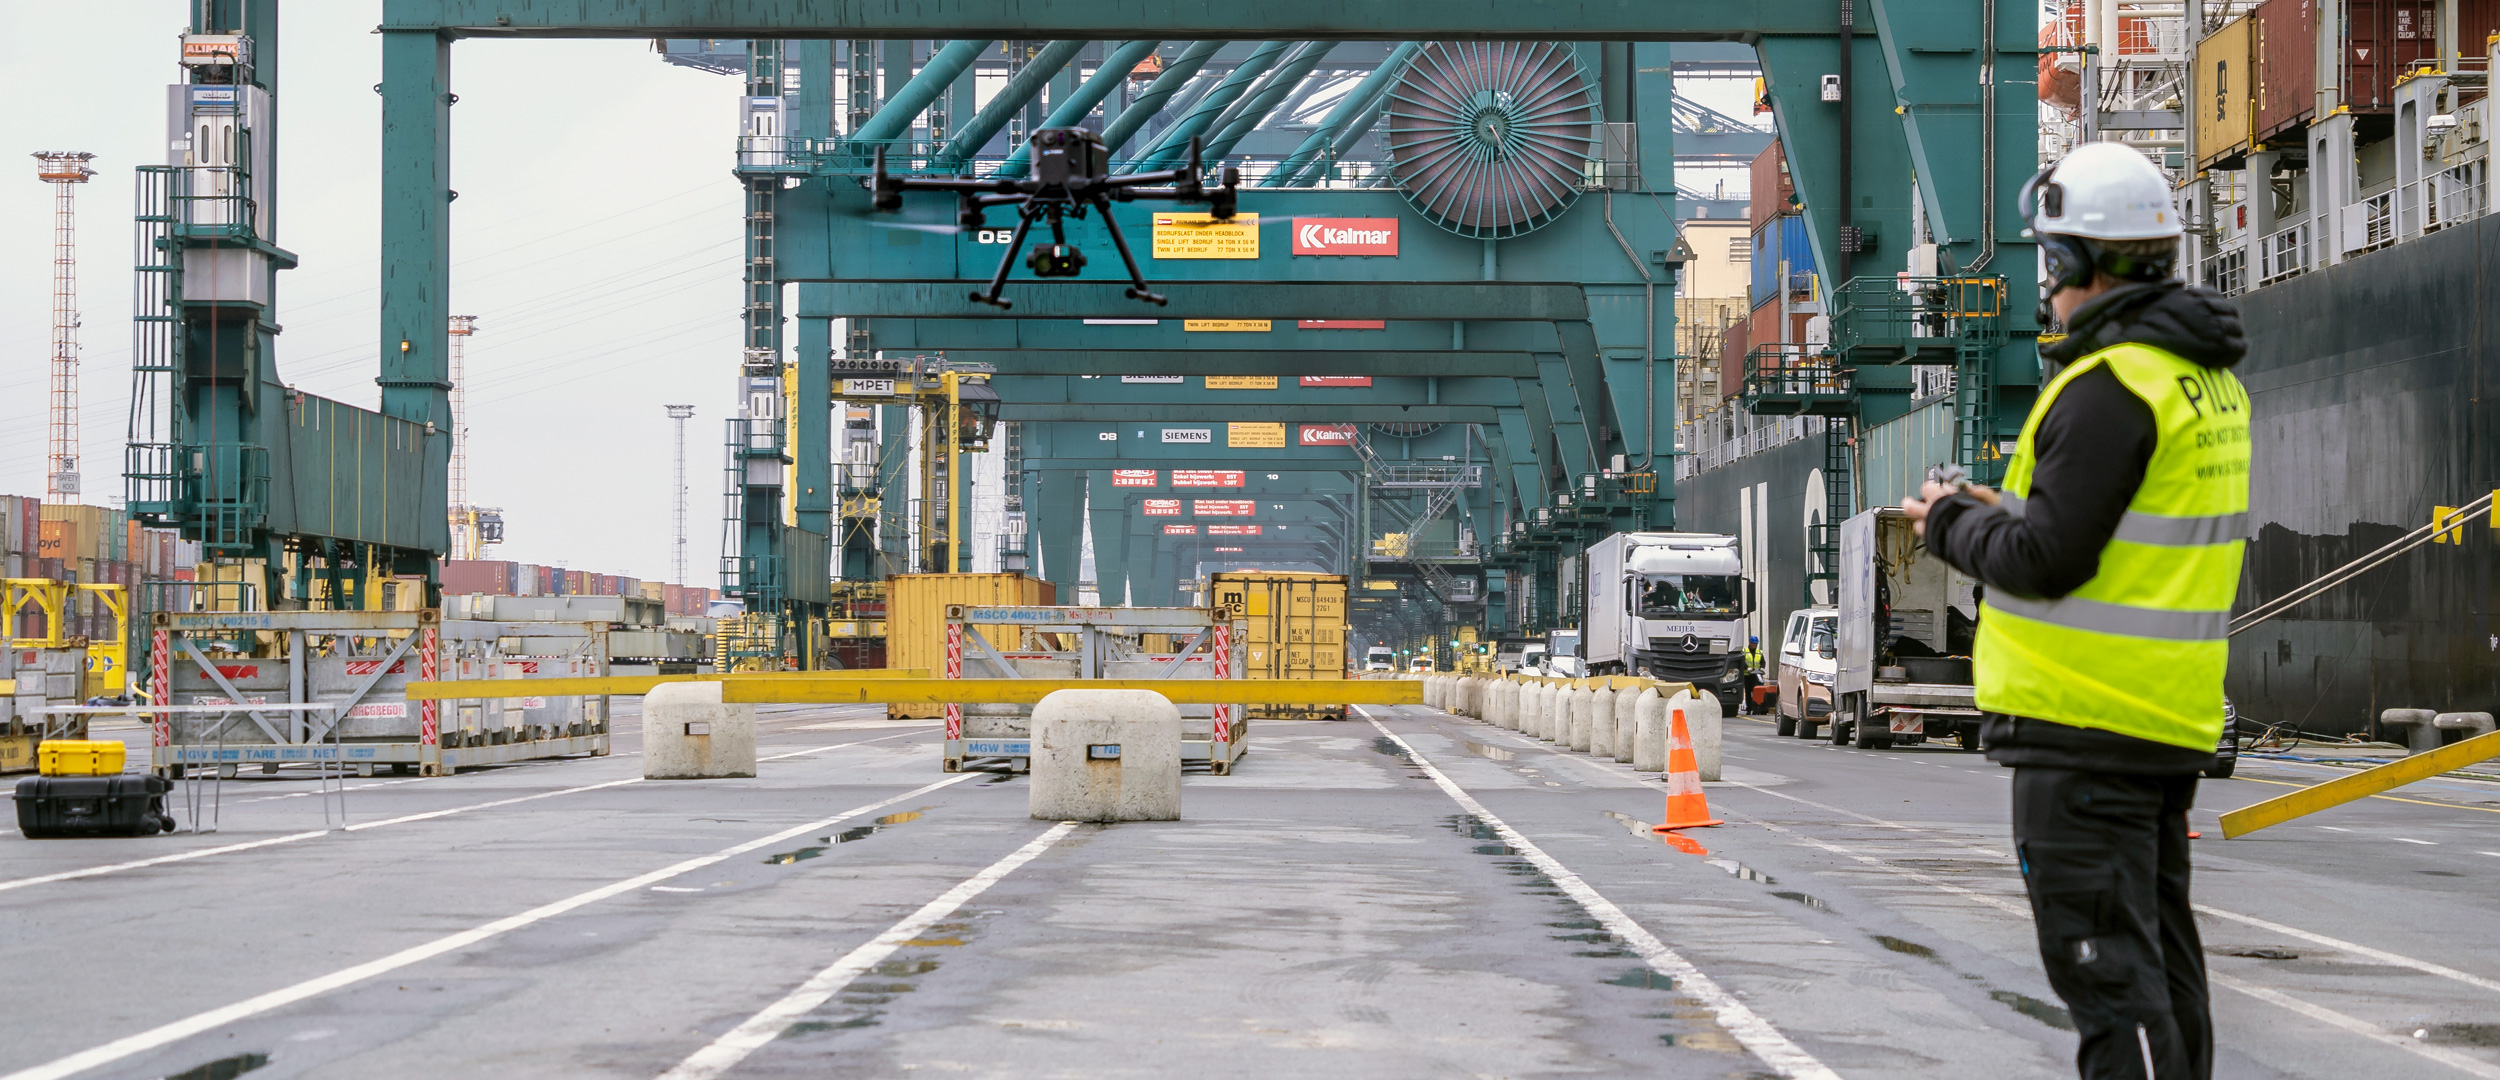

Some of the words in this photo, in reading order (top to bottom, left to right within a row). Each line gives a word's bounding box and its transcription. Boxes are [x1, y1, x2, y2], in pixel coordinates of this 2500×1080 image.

[186, 44, 236, 53] ALIMAK
[978, 230, 1012, 244] 05
[1324, 228, 1391, 244] Kalmar
[853, 380, 892, 390] MPET
[1099, 432, 1118, 440] 08
[64, 459, 74, 468] 156
[972, 610, 1008, 620] MSCO
[1011, 610, 1050, 620] 400216
[969, 744, 1000, 752] MGW
[178, 750, 207, 759] MGW
[246, 750, 276, 759] TARE
[313, 750, 337, 758] NET
